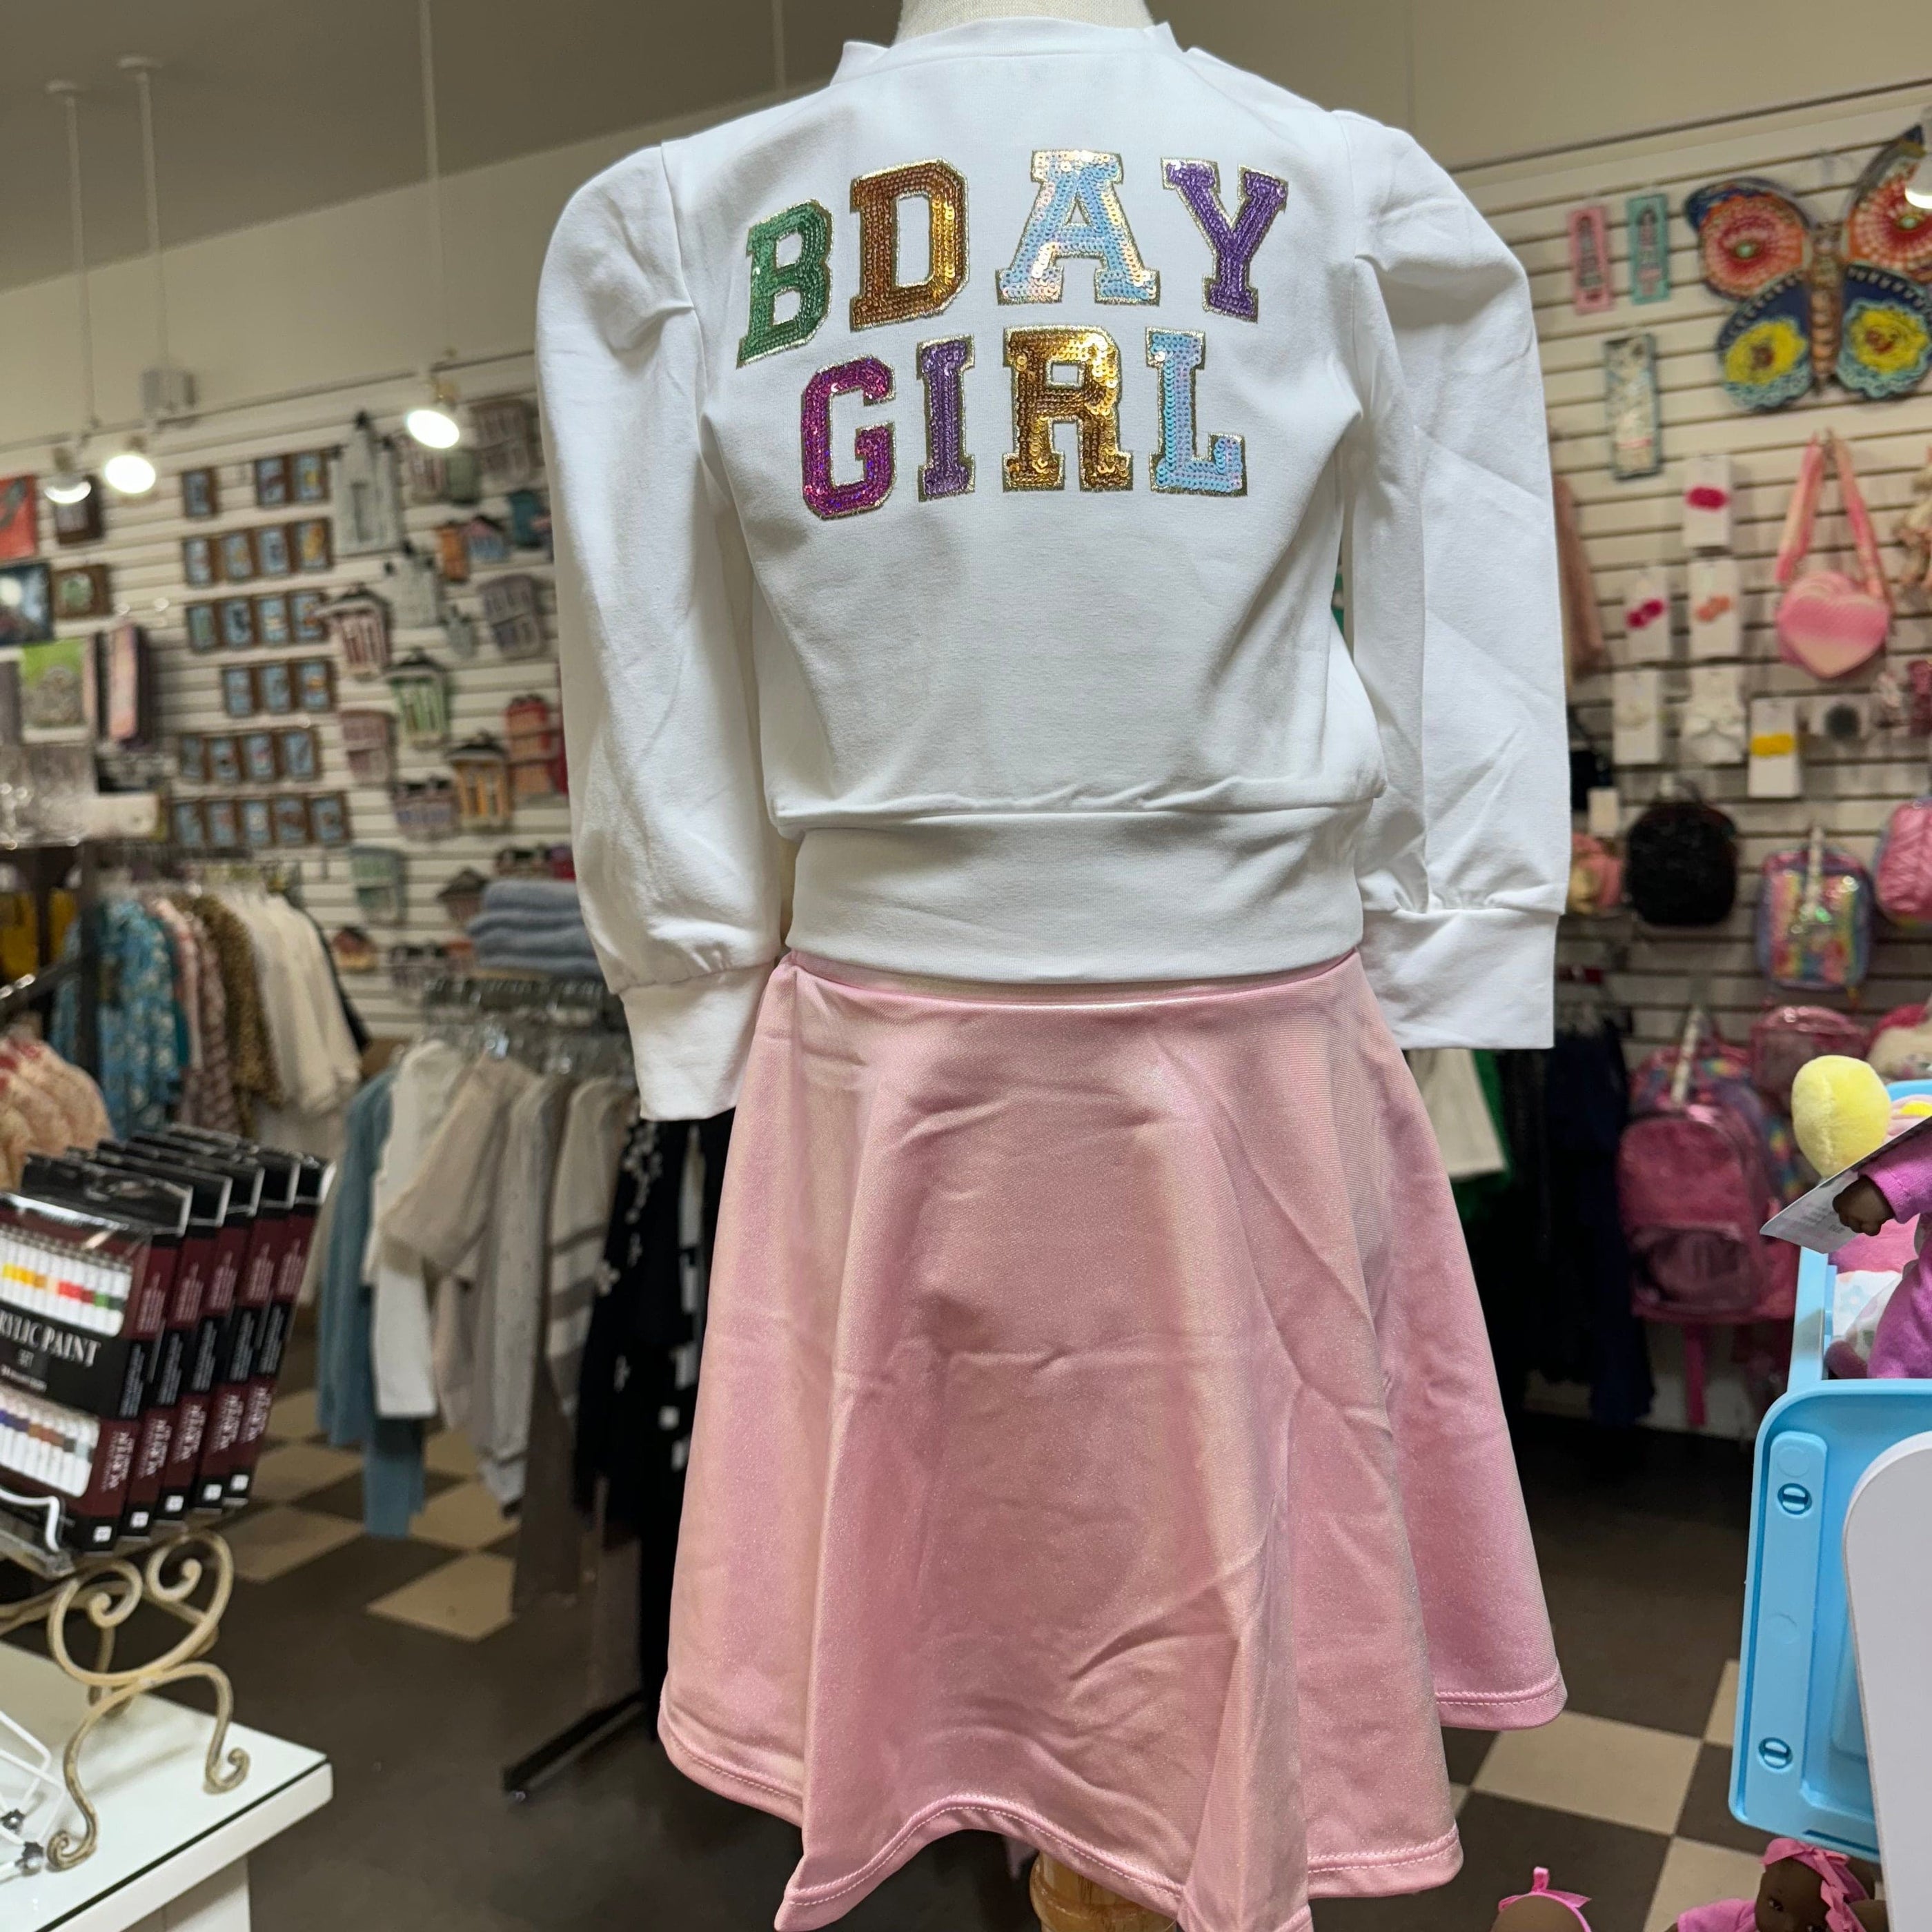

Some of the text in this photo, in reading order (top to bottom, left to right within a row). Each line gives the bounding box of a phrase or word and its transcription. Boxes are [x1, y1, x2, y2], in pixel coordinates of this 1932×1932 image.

[736, 149, 1288, 368] BDAY
[800, 324, 1249, 520] GIRL
[40, 1325, 101, 1368] PAINT
